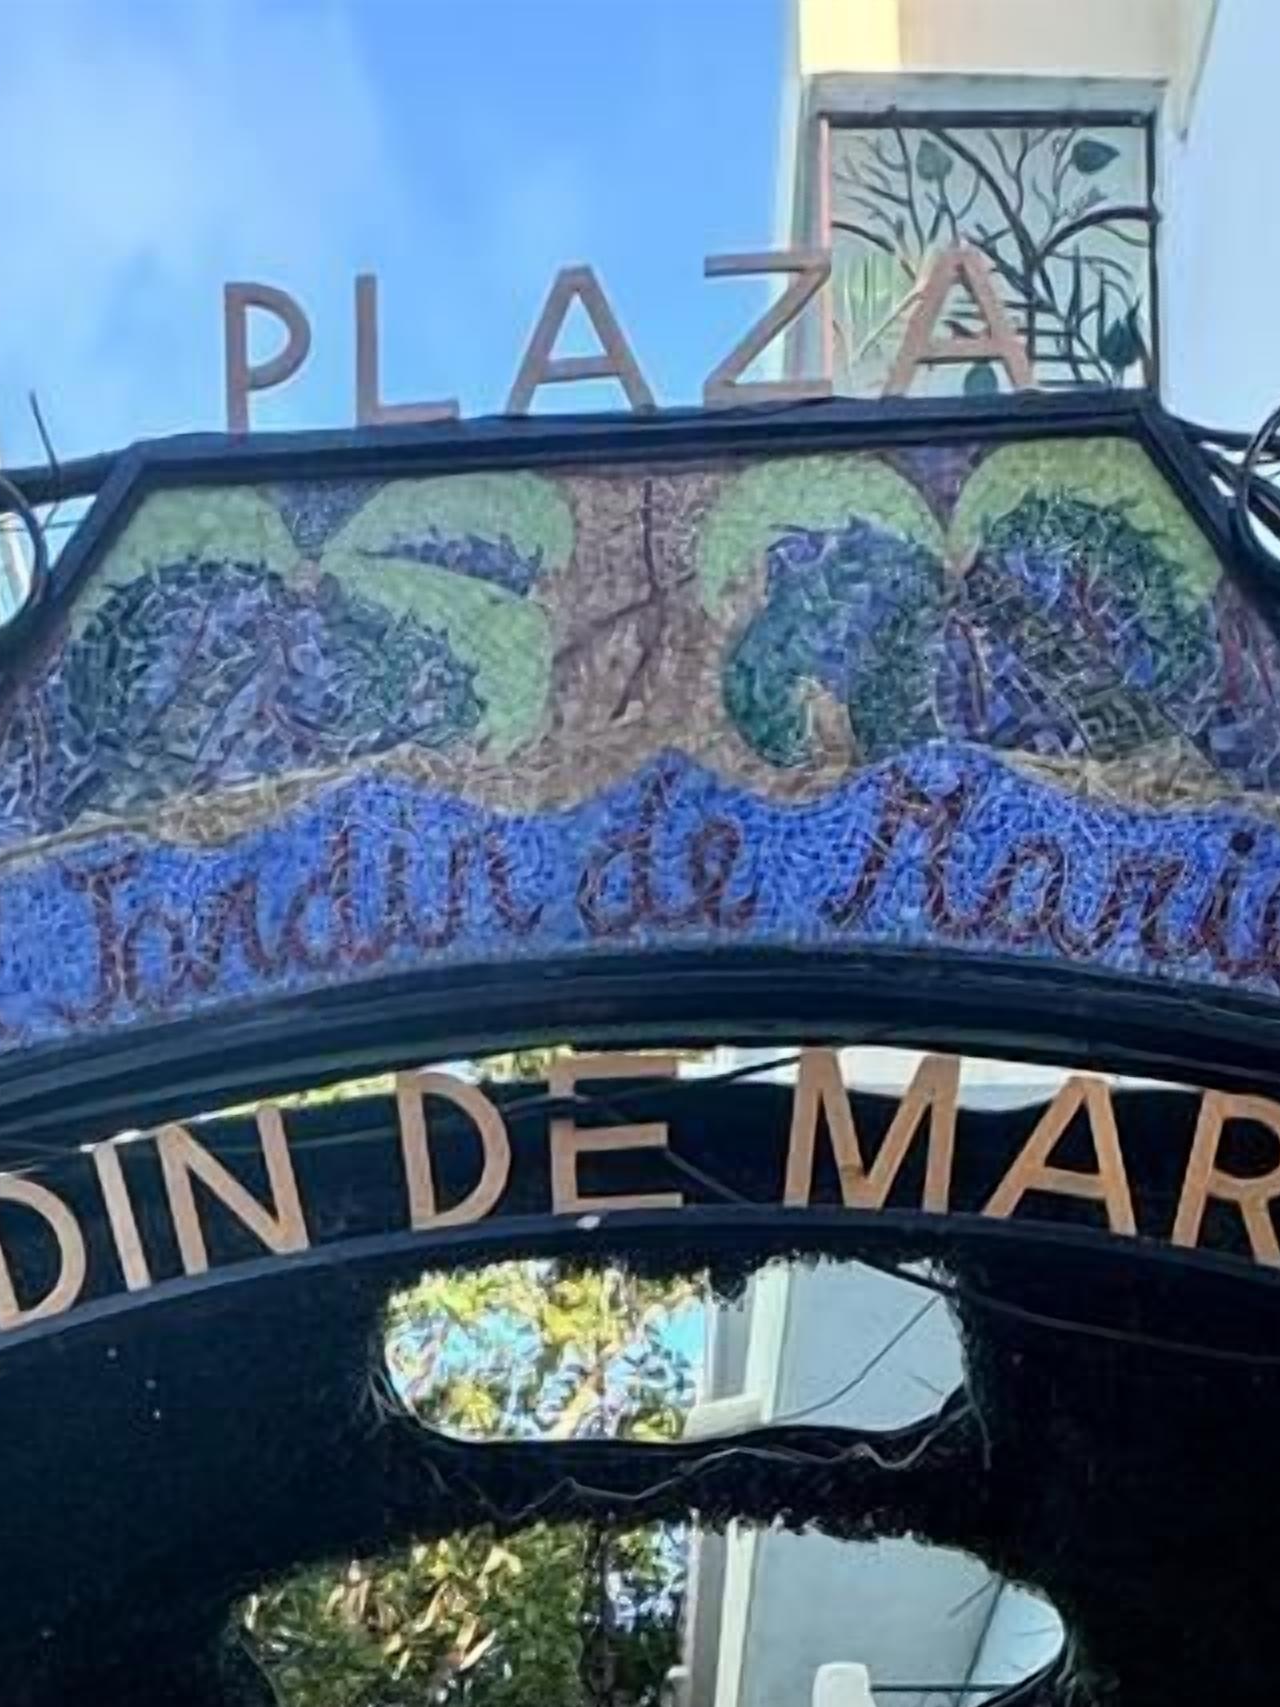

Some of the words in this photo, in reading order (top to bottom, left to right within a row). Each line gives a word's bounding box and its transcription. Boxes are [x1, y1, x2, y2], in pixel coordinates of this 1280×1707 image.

[223, 242, 1035, 442] PLAZA
[576, 762, 760, 938] de
[394, 1054, 683, 1232] DE
